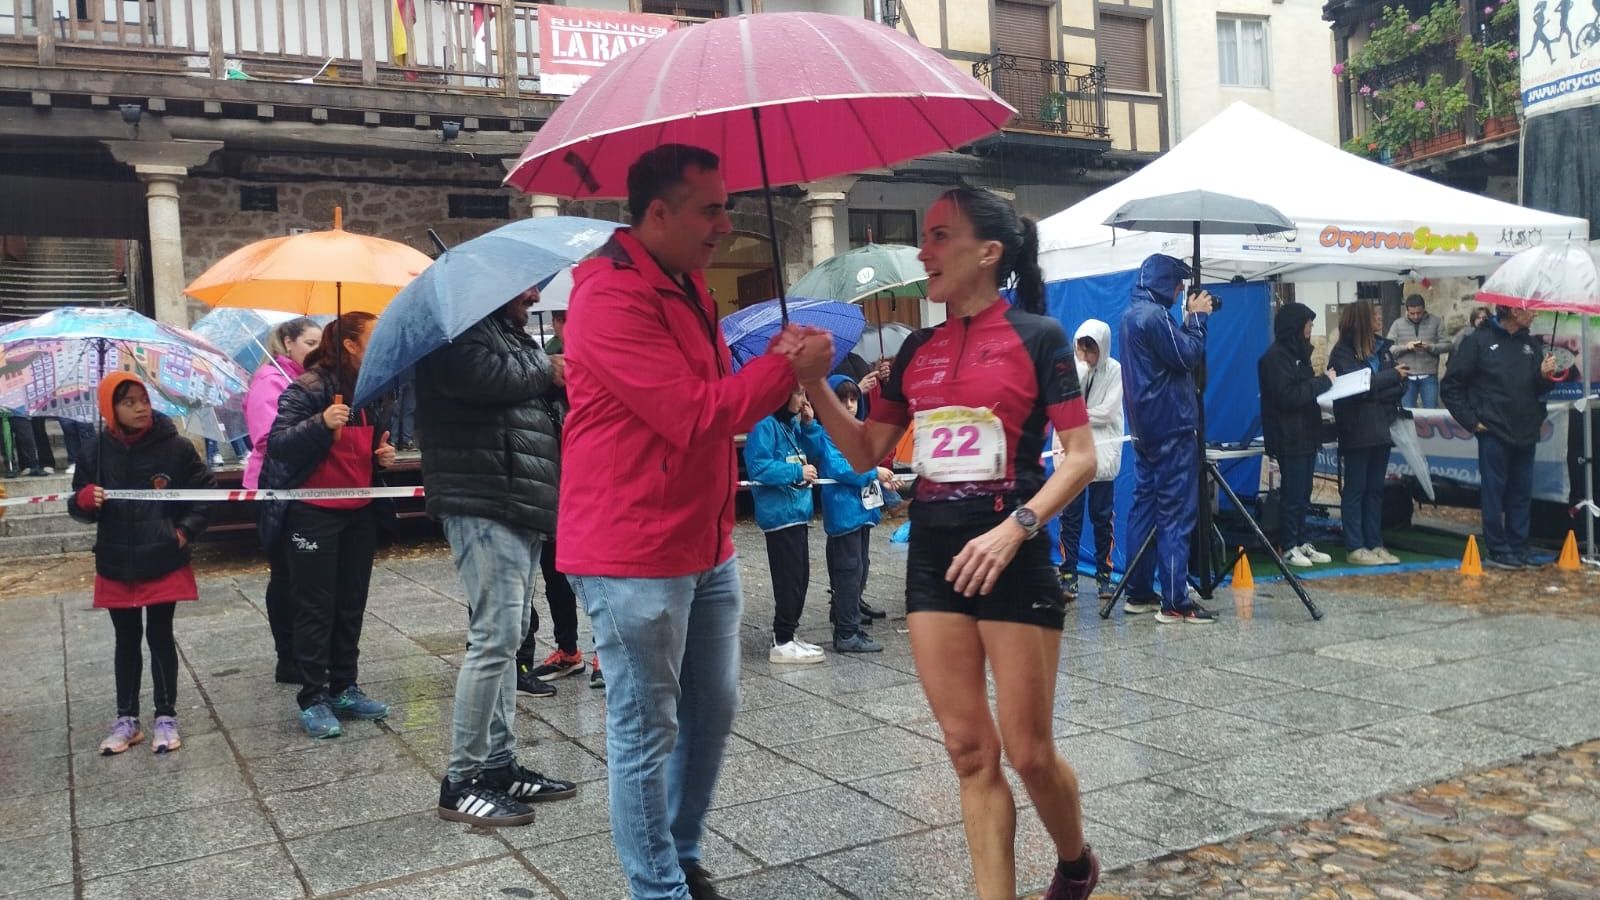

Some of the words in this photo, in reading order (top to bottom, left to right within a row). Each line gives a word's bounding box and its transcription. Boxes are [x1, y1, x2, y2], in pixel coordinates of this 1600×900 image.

[551, 17, 667, 37] RUNNING
[551, 30, 587, 58] LA
[1319, 225, 1479, 255] OrycronSport
[931, 425, 981, 459] 22
[357, 487, 371, 497] de
